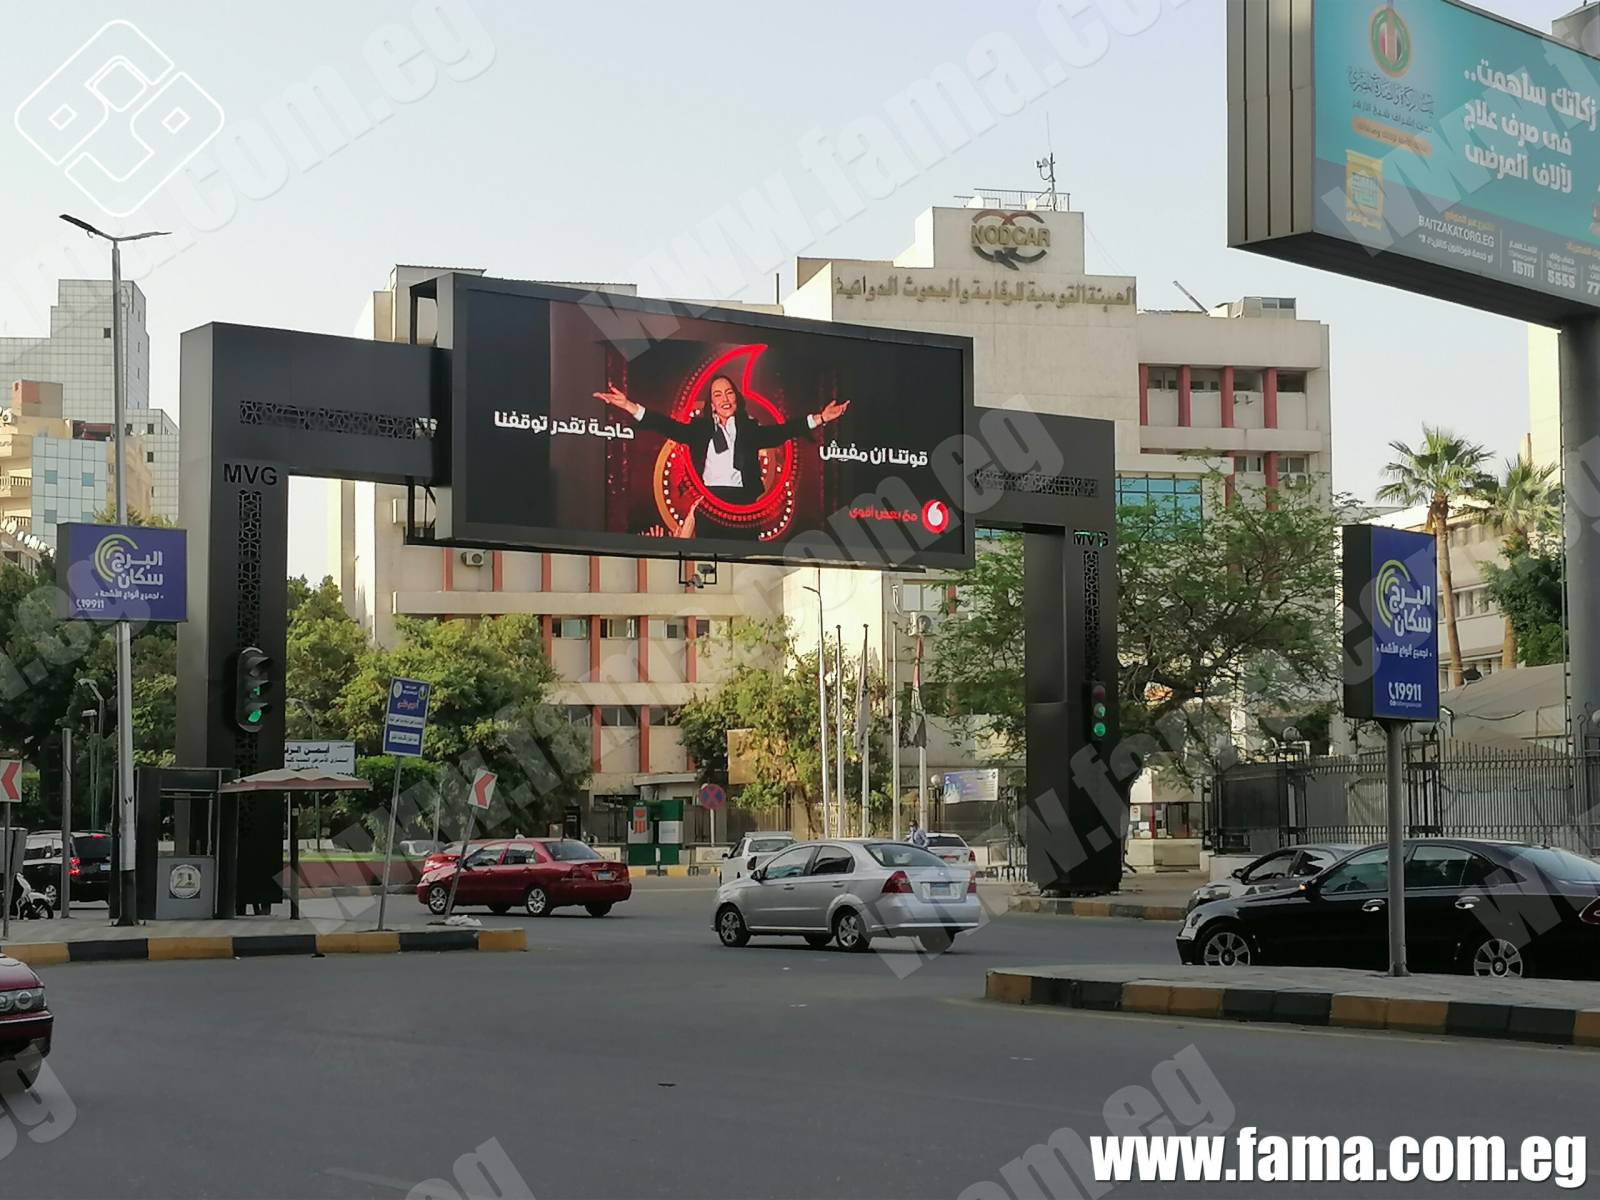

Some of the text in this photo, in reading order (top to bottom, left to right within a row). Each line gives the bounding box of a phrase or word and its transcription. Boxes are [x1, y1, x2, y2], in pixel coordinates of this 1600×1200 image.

[1464, 99, 1498, 131] علاج
[1551, 87, 1597, 132] زكاتك
[1502, 113, 1540, 147] صرف
[1464, 144, 1529, 180] المرضى
[971, 224, 1050, 247] NODCAR
[1418, 214, 1495, 248] BAITZAKAT.ORG.EG
[1547, 269, 1576, 289] 5555
[494, 410, 635, 440] حاجة تقدر توقفنا
[819, 440, 868, 461] مفيش
[888, 449, 928, 468] قوتنا
[223, 463, 277, 486] MVG
[1073, 529, 1109, 547] MVG
[118, 567, 163, 588] سكان
[1394, 608, 1432, 637] سكان
[1394, 682, 1421, 701] 19911
